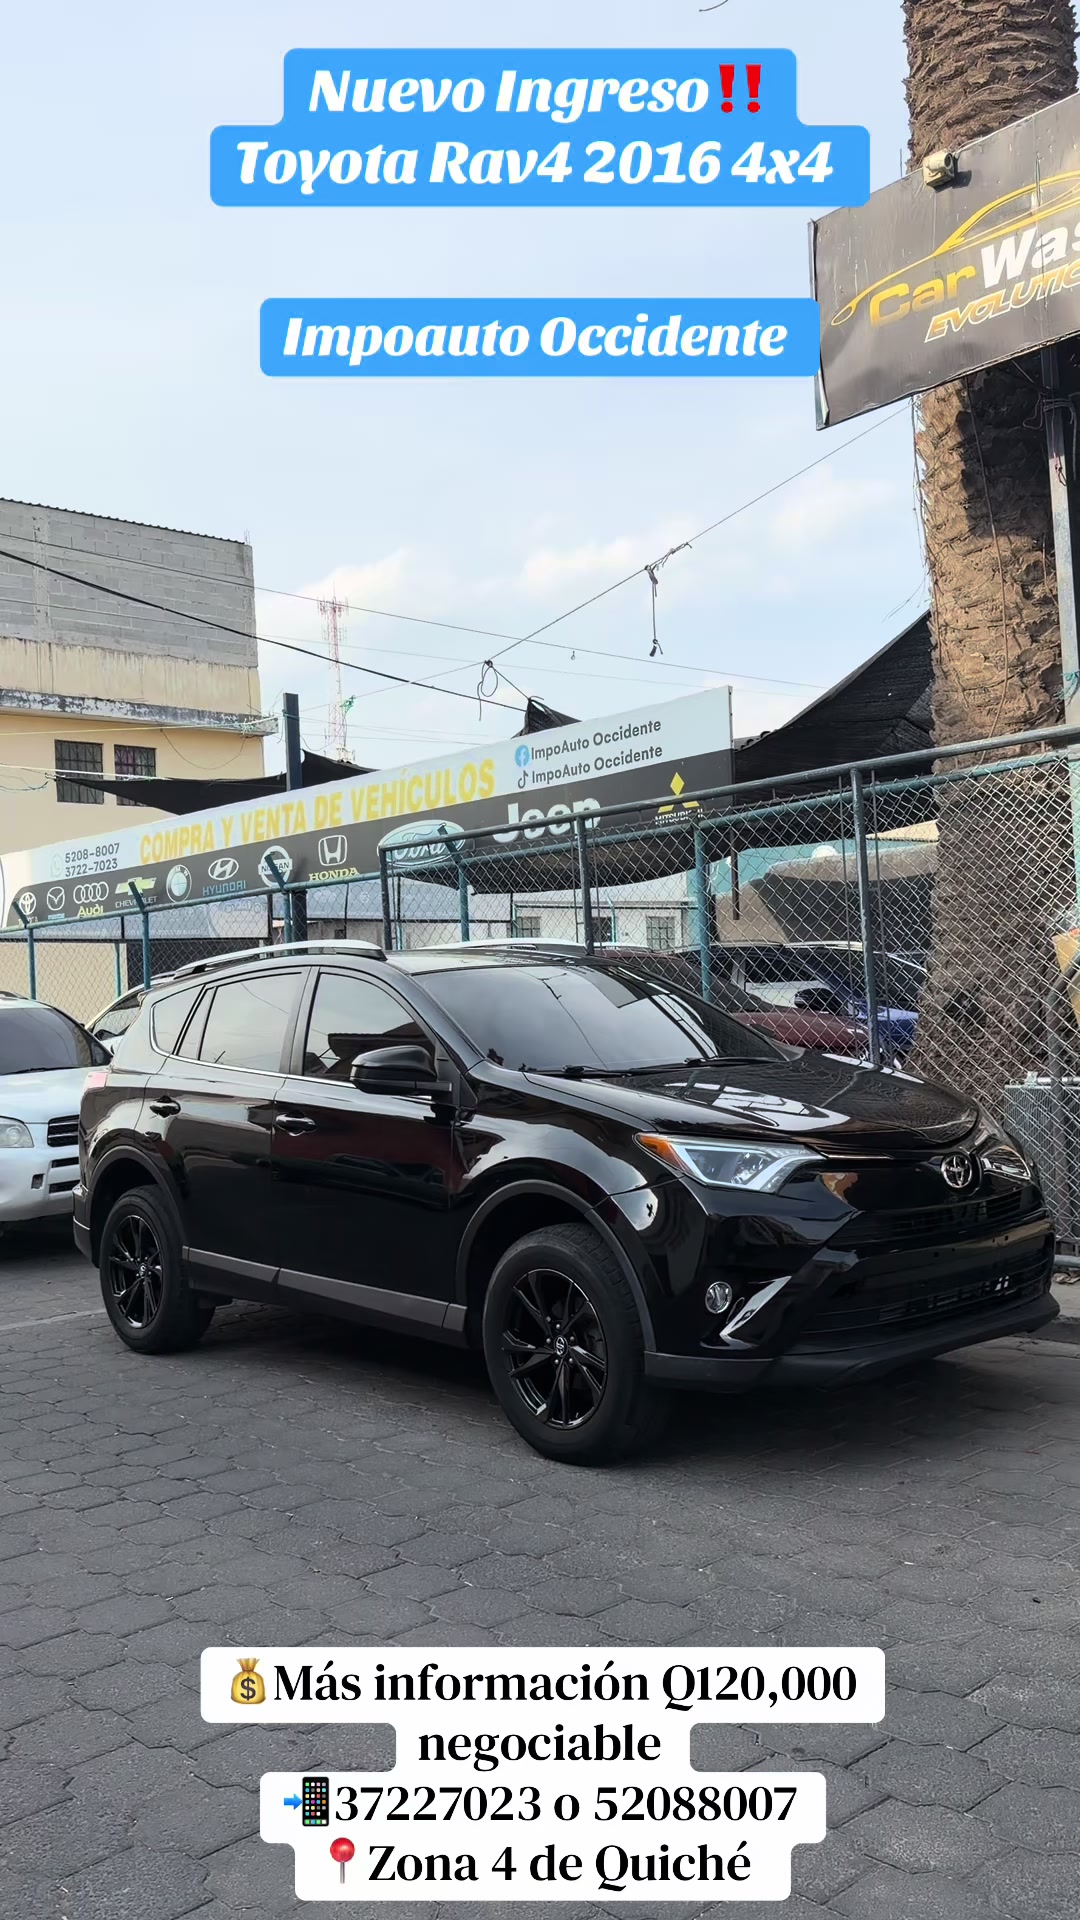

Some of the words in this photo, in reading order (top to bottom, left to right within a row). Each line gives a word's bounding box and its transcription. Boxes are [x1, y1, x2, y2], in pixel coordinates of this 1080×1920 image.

[870, 265, 976, 328] Car
[980, 222, 1080, 289] Wa
[531, 738, 589, 763] ImpoAuto
[593, 720, 662, 746] Occidente
[532, 763, 590, 785] ImpoAuto
[594, 746, 663, 772] Occidente
[140, 820, 215, 865] COMPRA
[222, 815, 234, 848] Y
[240, 800, 307, 844] VENTA
[314, 791, 343, 829] DE
[351, 758, 495, 822] VEHÍCULOS
[492, 798, 601, 843] Jeep
[655, 808, 704, 825] MITSUBII
[65, 843, 120, 863] 5208-8007
[65, 858, 118, 877] 3722-7023
[261, 861, 290, 873] NIAN
[308, 867, 360, 882] HONDA
[202, 880, 247, 896] HYUNDAI
[76, 904, 104, 919] Audi
